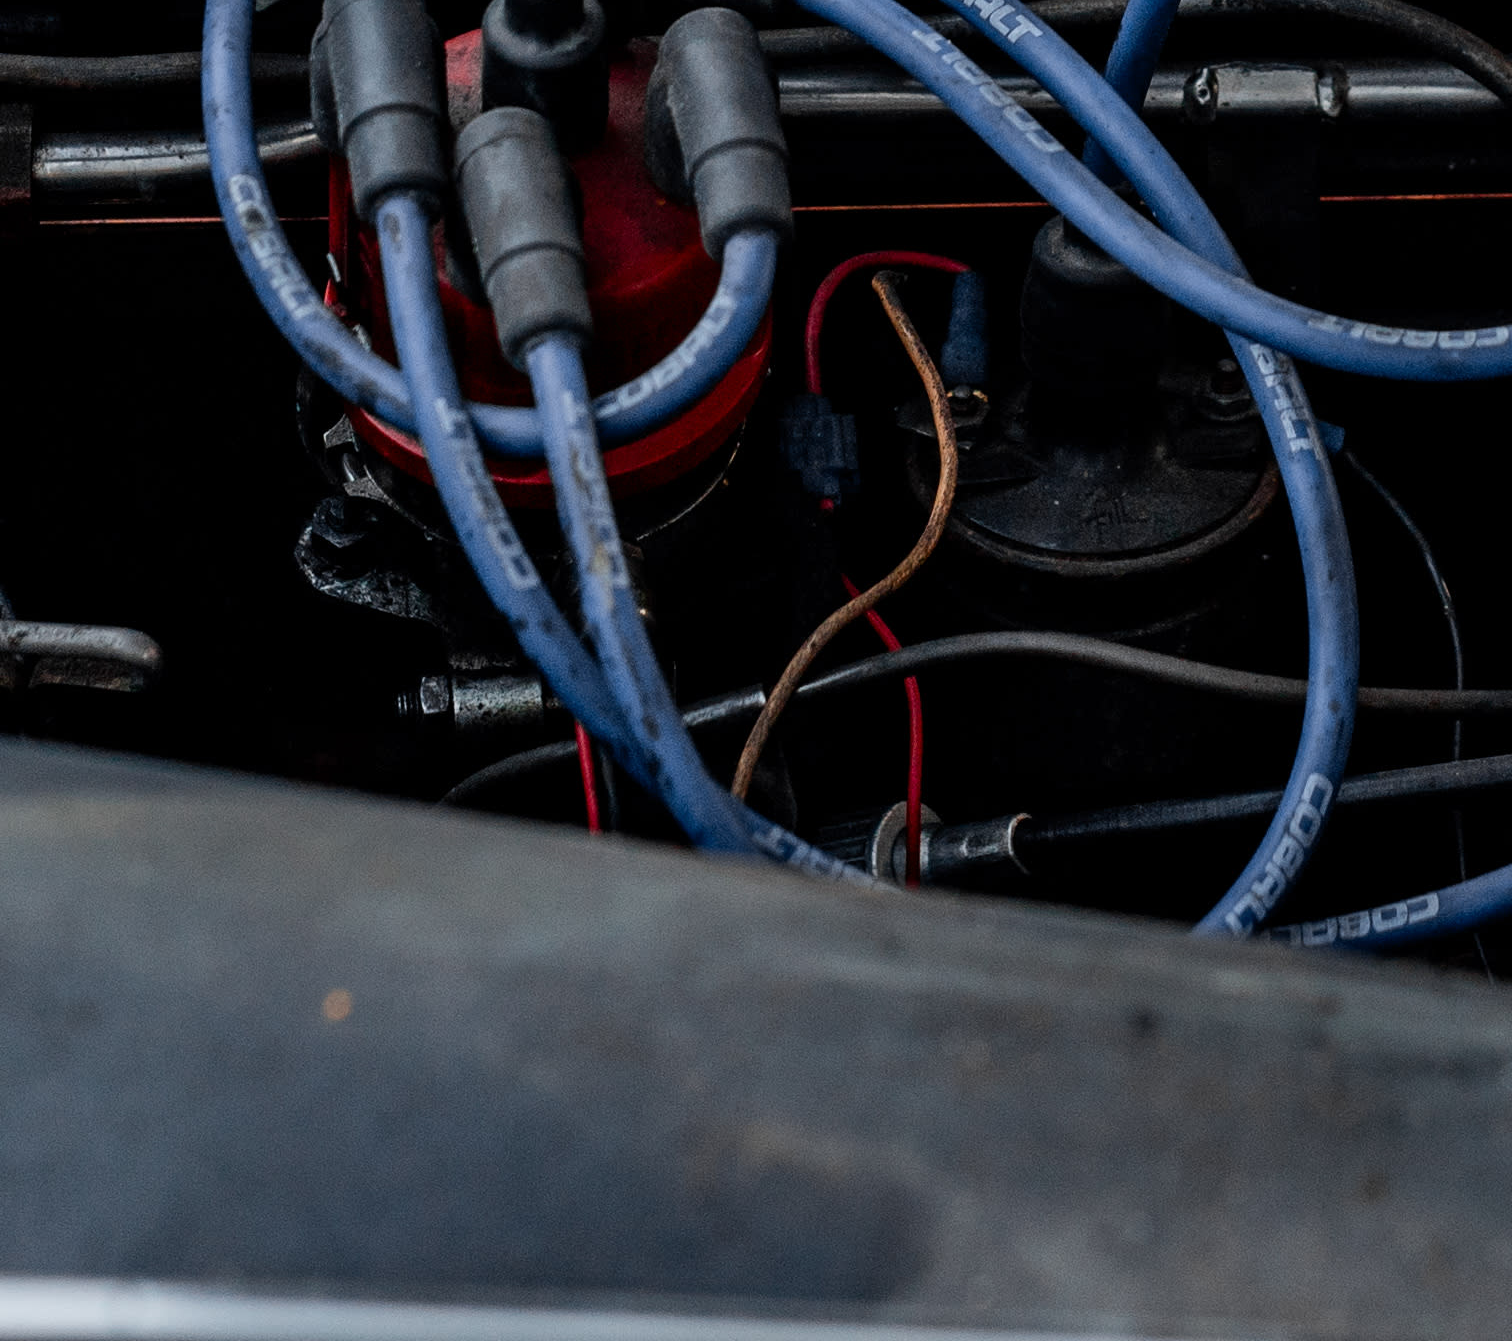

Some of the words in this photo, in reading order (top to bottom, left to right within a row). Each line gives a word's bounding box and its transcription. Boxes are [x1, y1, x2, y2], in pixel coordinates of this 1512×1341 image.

[911, 27, 1065, 154] COBALT
[228, 173, 333, 321] COBALT
[1249, 342, 1322, 457] BALT
[1307, 314, 1510, 350] COBALT
[434, 396, 539, 591] COBALT
[1224, 772, 1334, 937] COBALT
